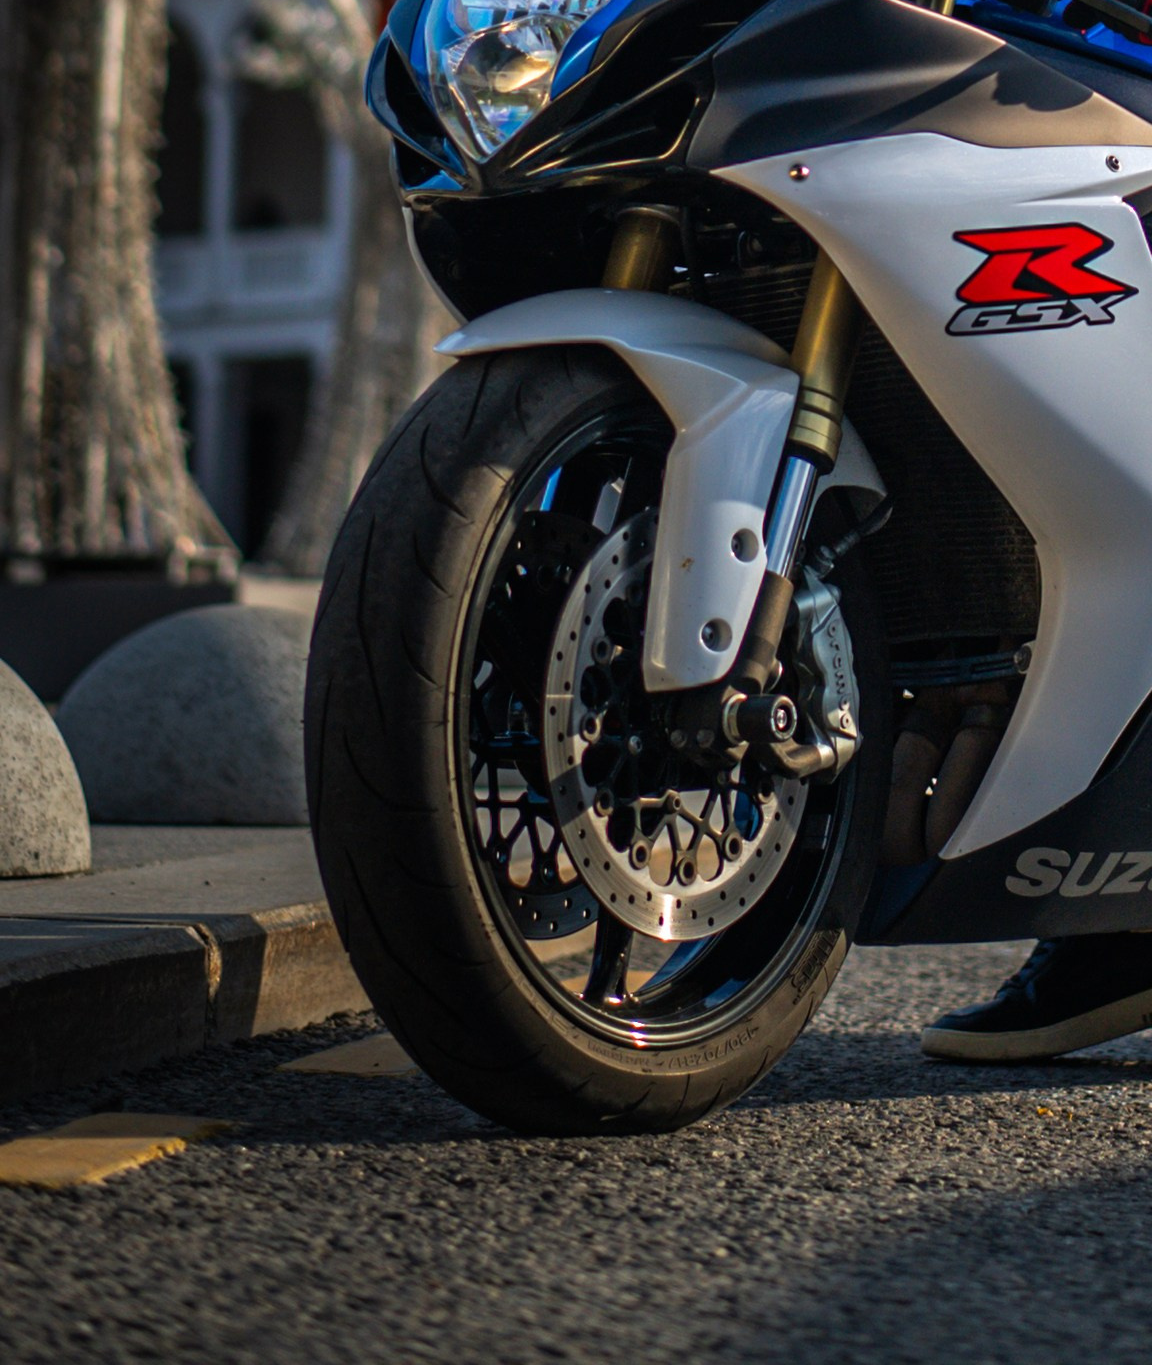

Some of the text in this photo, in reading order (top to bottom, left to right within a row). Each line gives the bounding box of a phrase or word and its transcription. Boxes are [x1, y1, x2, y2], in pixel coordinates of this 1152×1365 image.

[953, 222, 1139, 305] R
[945, 293, 1137, 336] GSX
[826, 617, 856, 730] brembo
